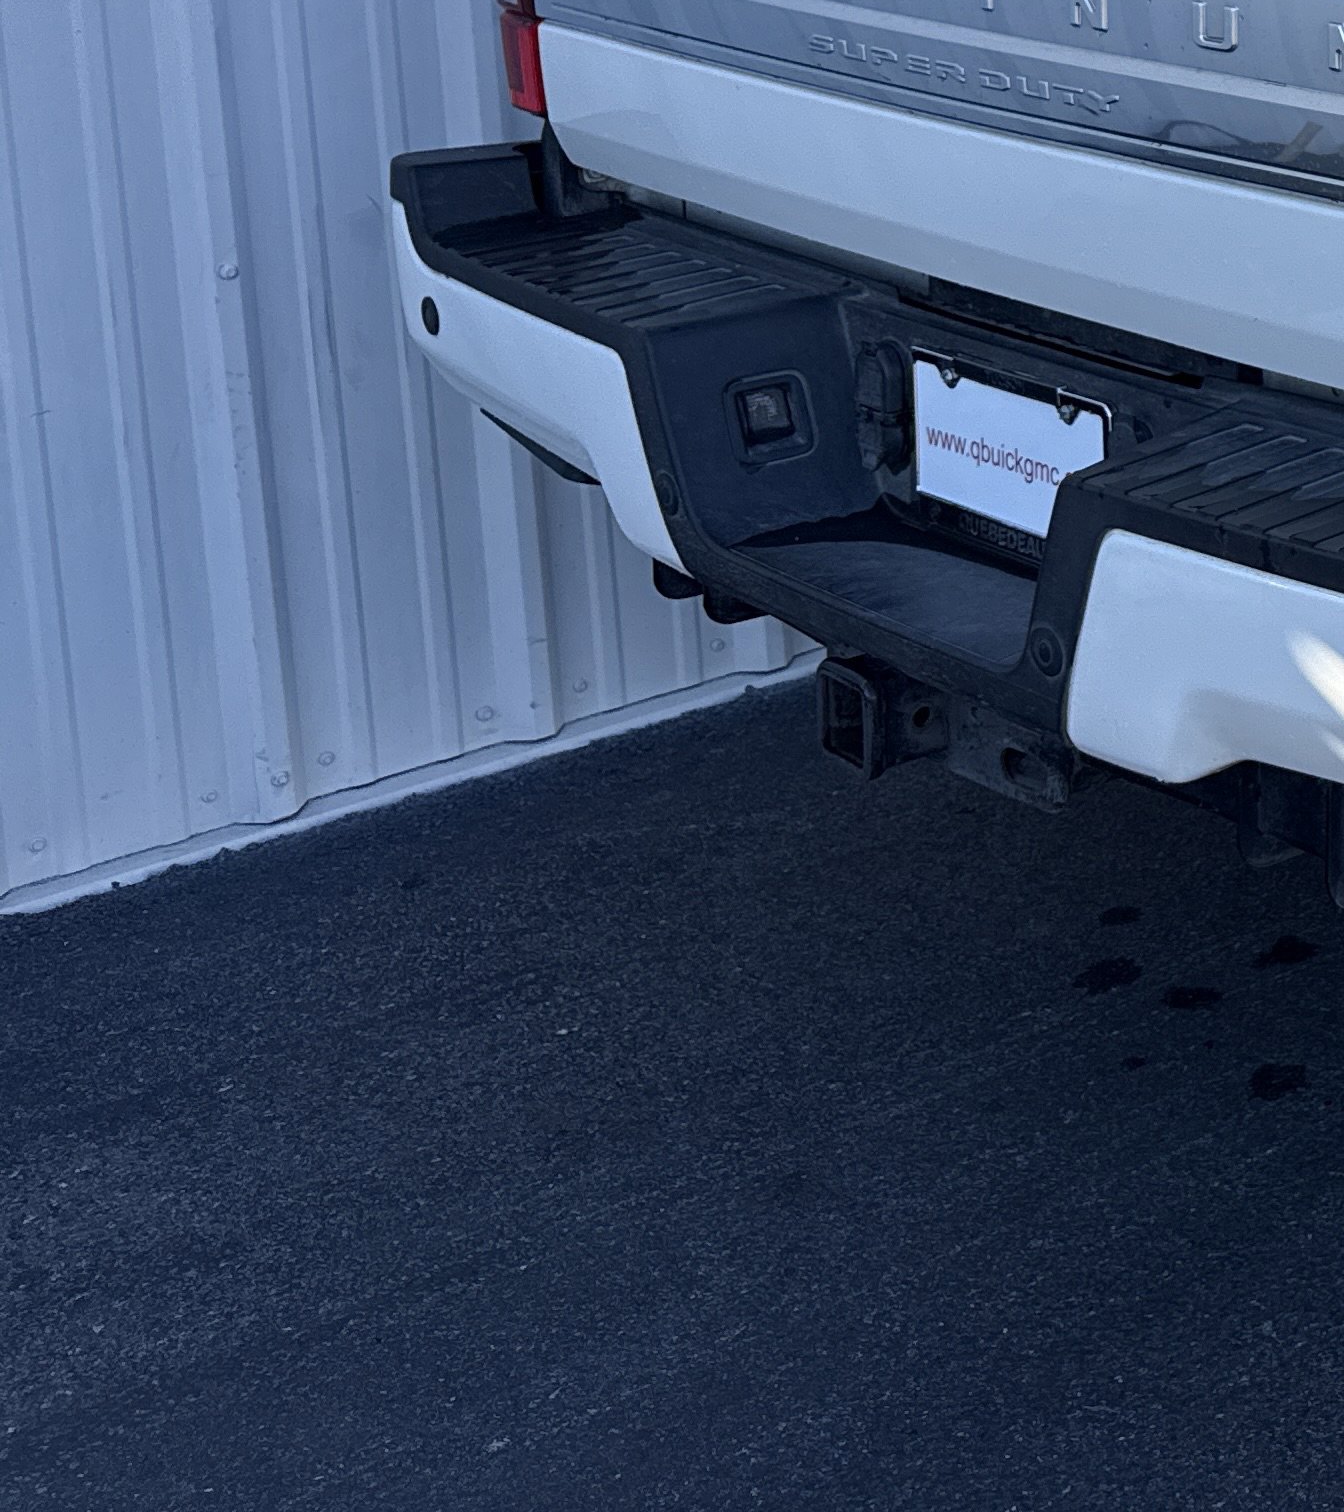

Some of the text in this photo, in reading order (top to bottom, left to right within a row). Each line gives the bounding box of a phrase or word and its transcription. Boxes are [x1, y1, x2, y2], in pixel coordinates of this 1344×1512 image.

[807, 33, 1121, 116] SUPER DUTY
[926, 425, 1072, 486] www.qbuickgmc
